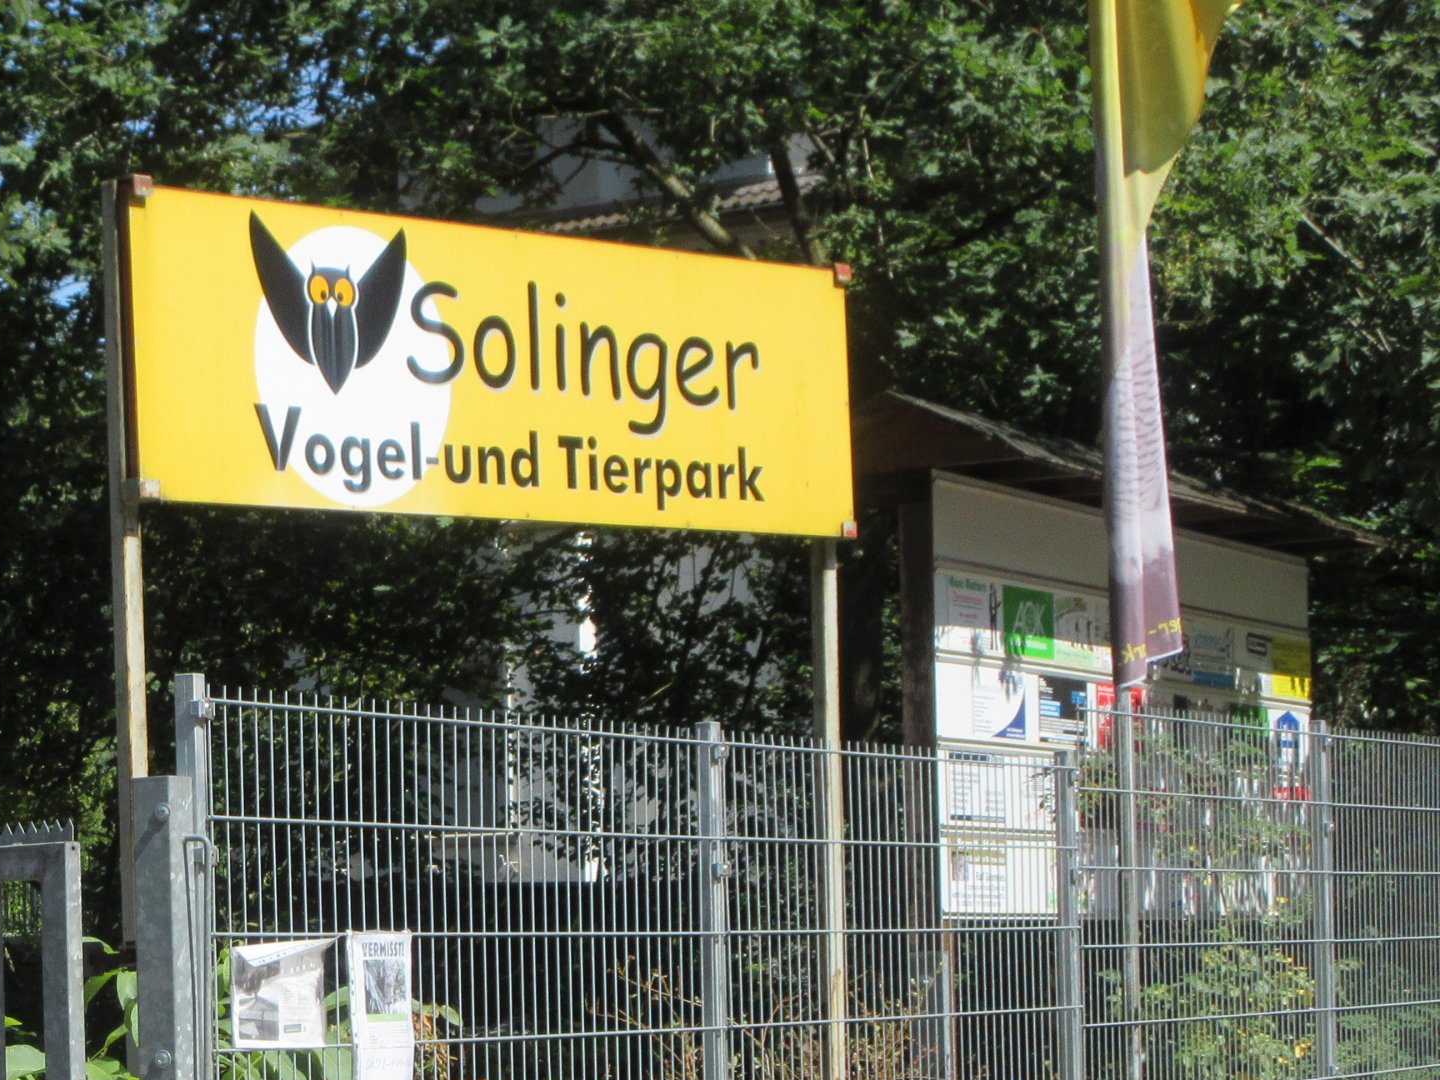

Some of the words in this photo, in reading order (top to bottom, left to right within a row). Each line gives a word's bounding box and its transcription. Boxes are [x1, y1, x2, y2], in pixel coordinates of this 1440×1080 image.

[405, 279, 759, 436] Solinger
[254, 402, 540, 493] Vogel-und
[559, 434, 765, 510] Tierpark
[1012, 599, 1047, 637] AOK
[361, 941, 405, 957] VERMISST!
